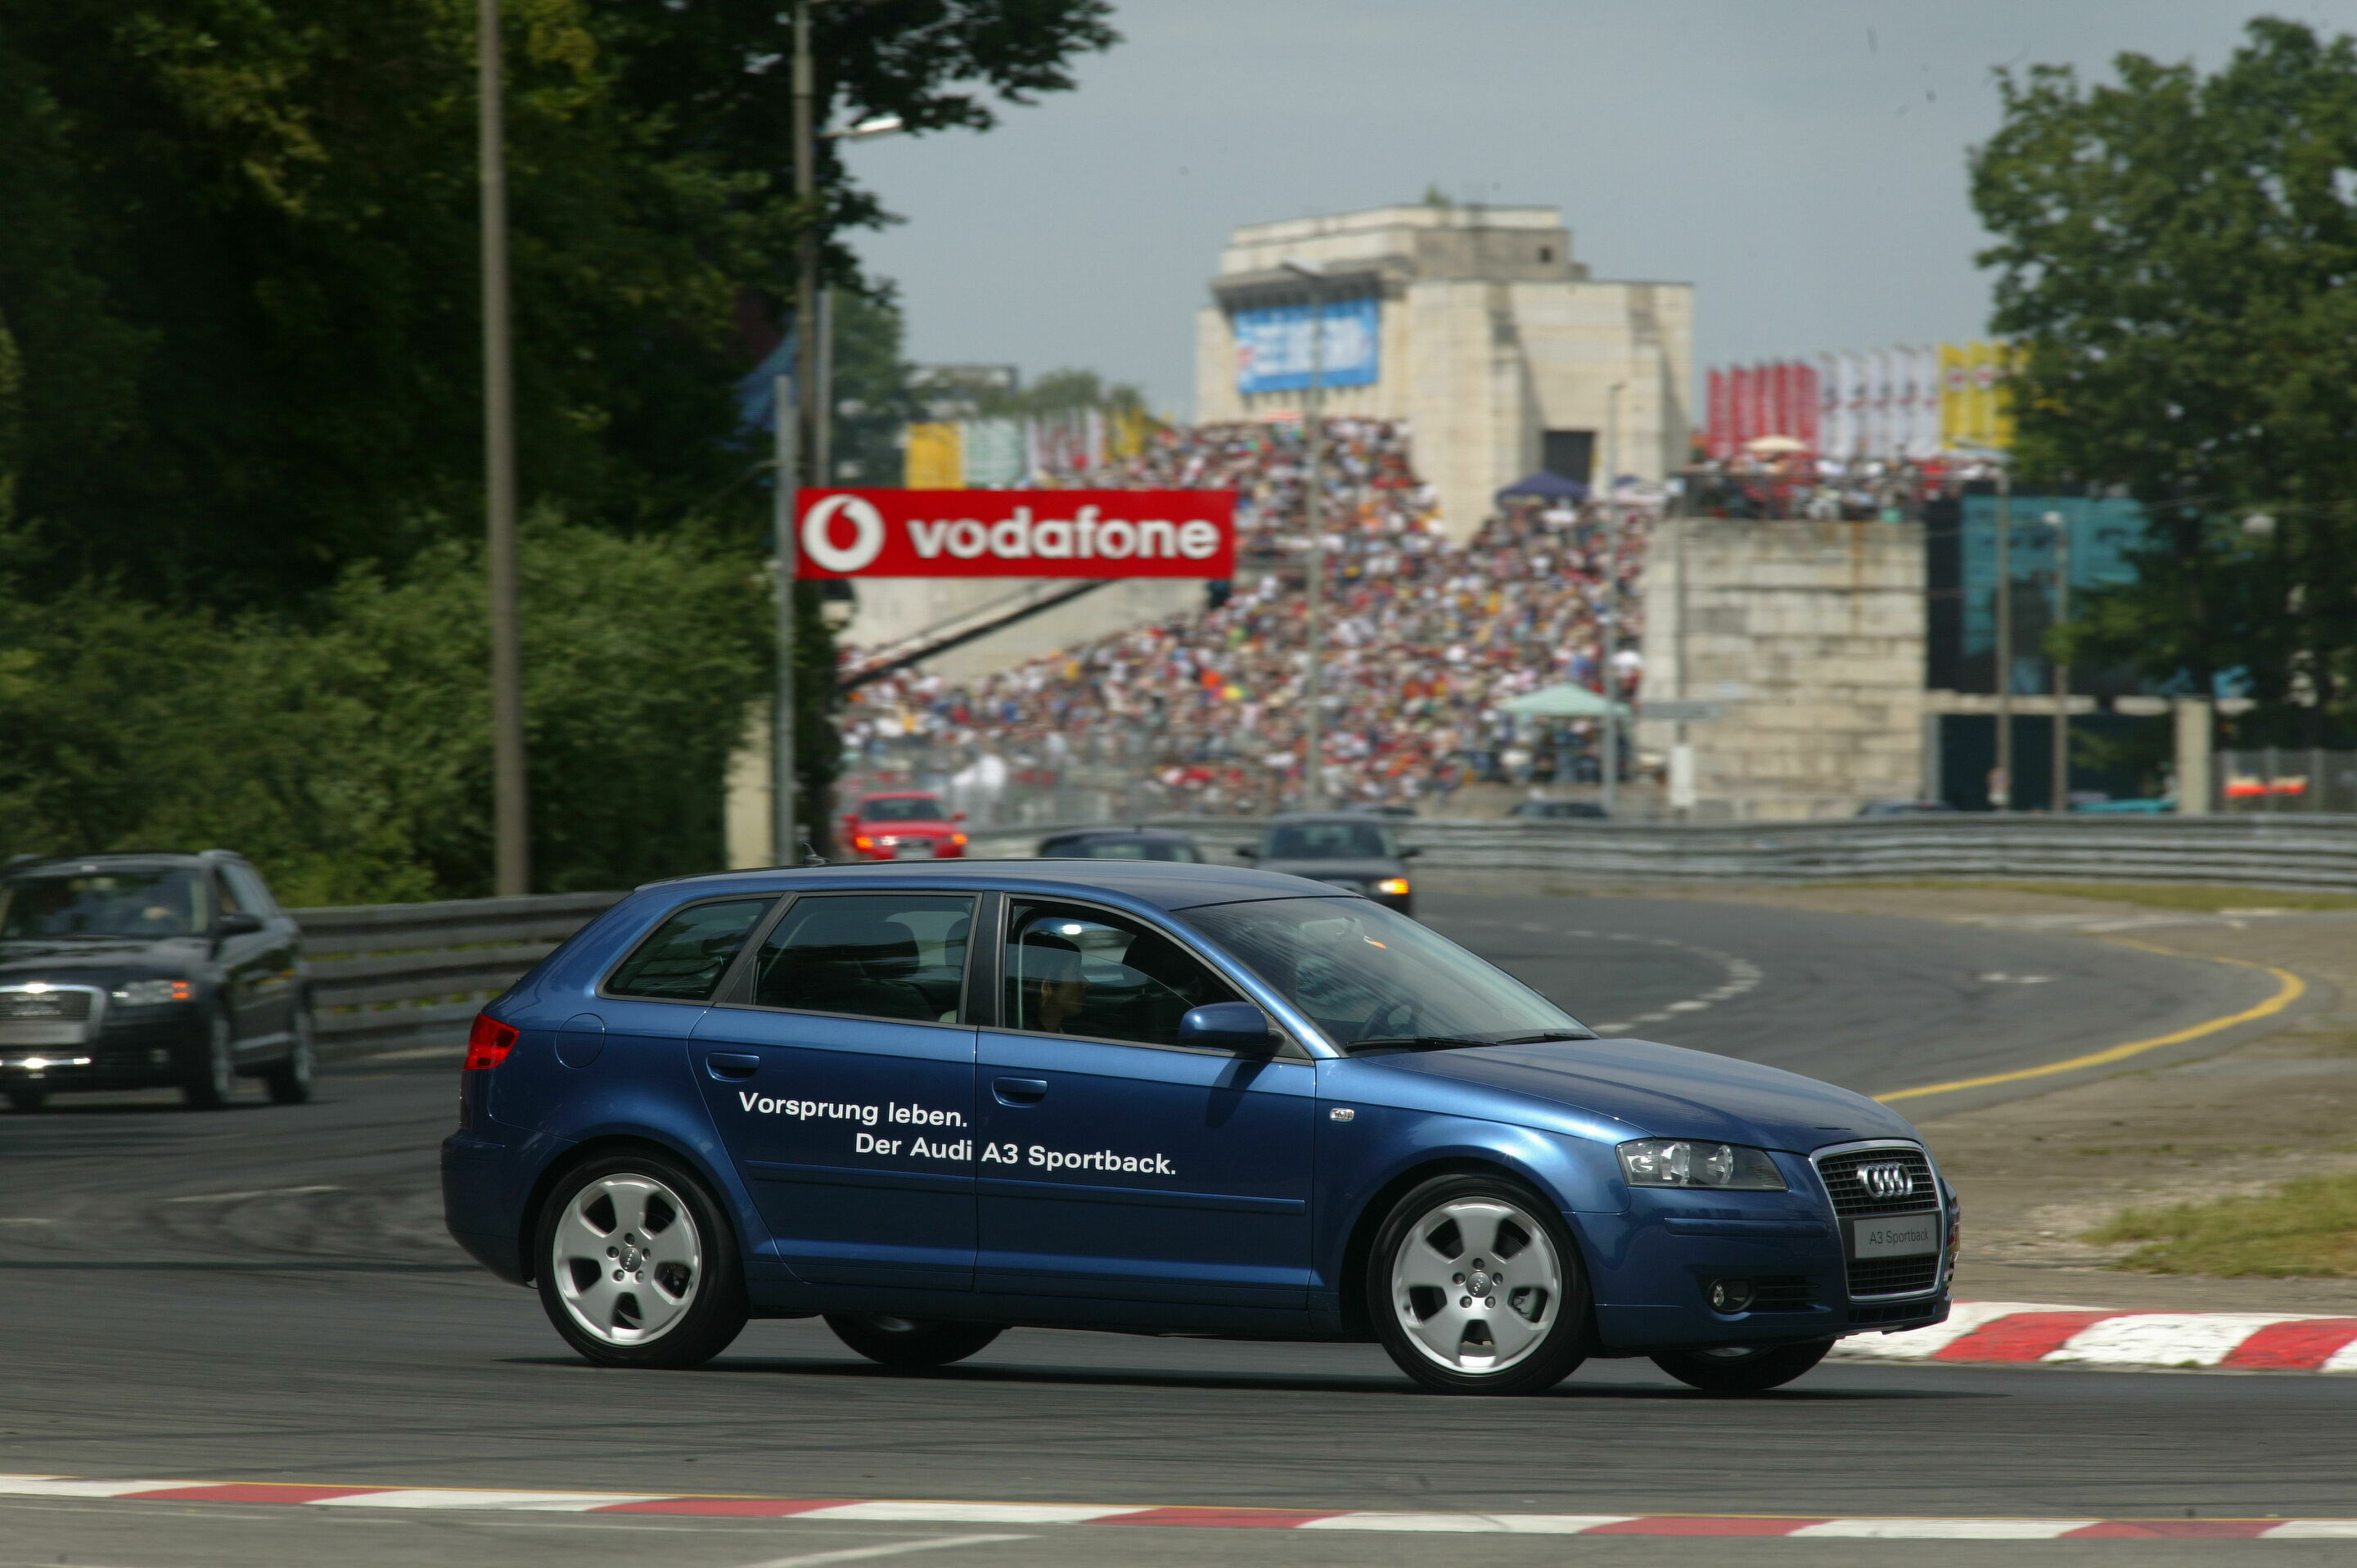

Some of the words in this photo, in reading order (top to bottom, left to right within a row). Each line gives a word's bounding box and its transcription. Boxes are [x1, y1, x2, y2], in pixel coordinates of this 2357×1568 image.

[907, 505, 1220, 560] vodafone
[738, 1091, 879, 1126] Vorsprung
[888, 1102, 967, 1128] leben.
[855, 1133, 902, 1156] Der
[909, 1137, 972, 1161] Audi
[980, 1142, 1018, 1165] A3
[1028, 1145, 1176, 1175] Sportback.
[1869, 1230, 1883, 1245] A3
[1886, 1228, 1929, 1246] Sportback
